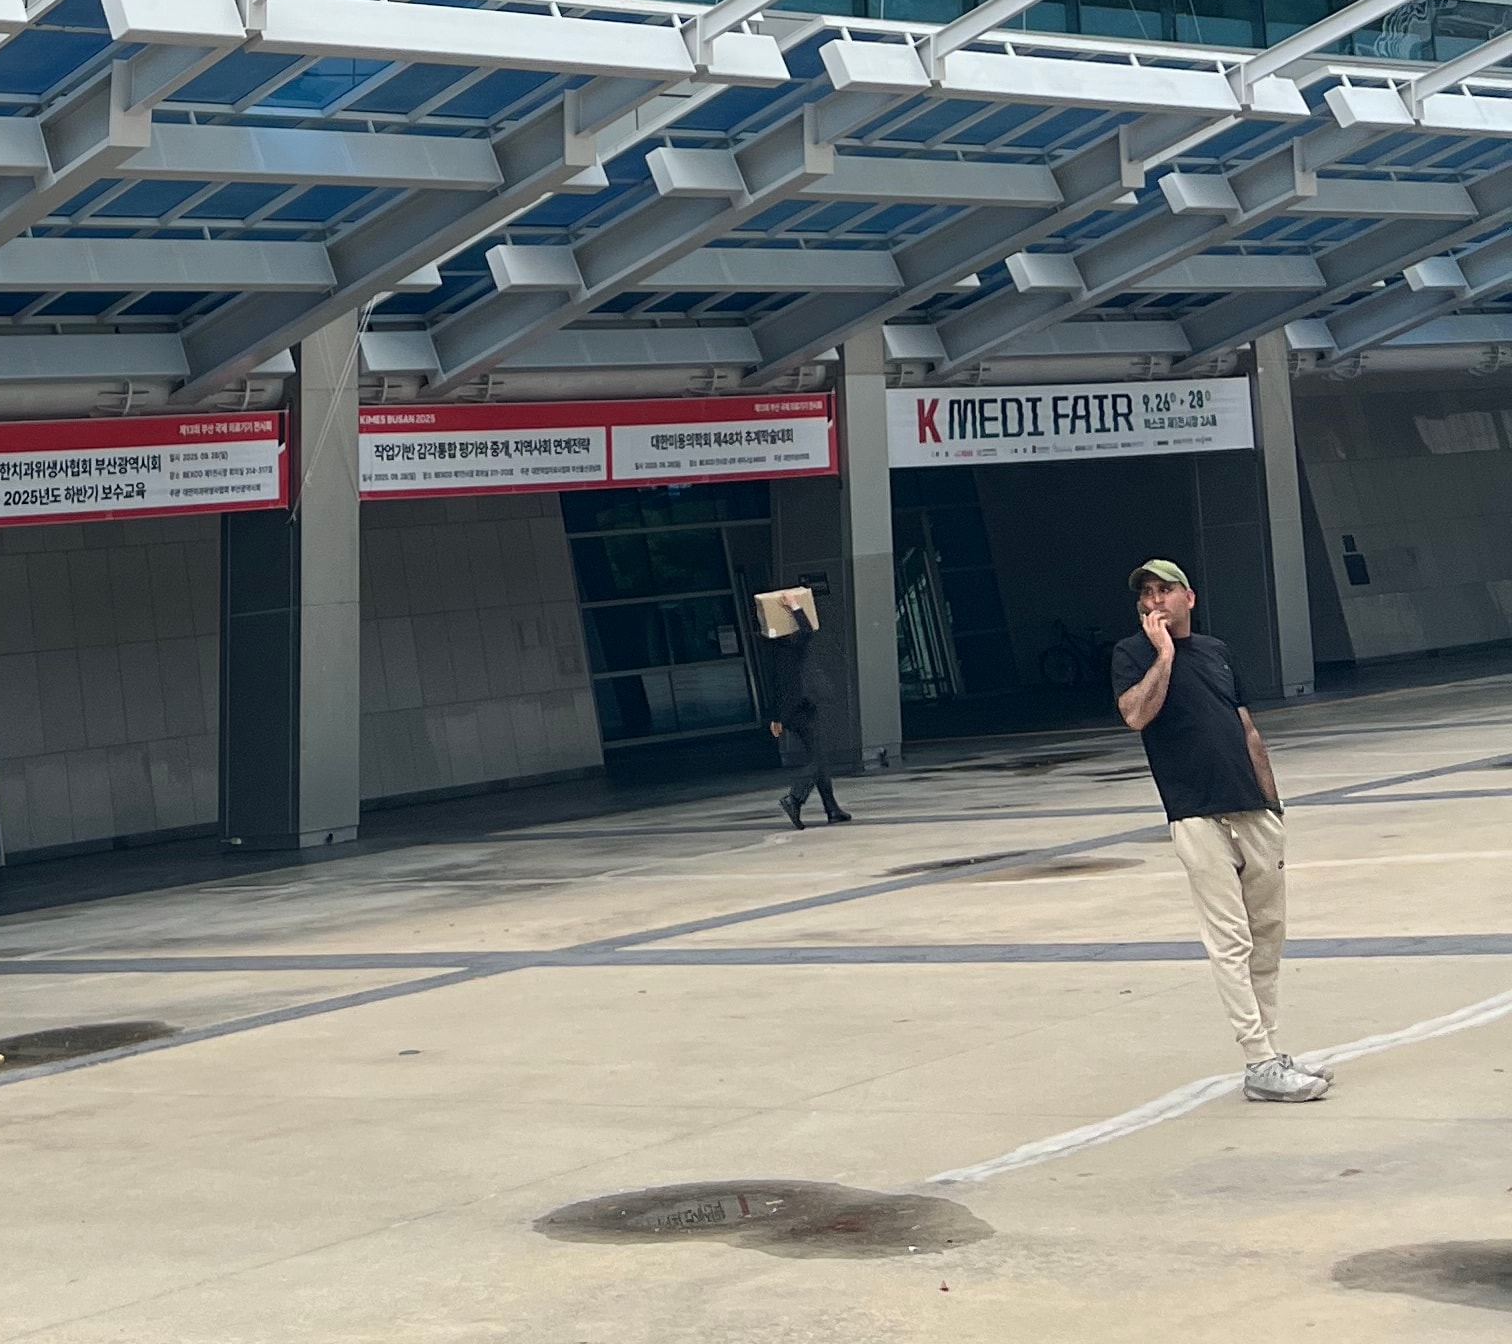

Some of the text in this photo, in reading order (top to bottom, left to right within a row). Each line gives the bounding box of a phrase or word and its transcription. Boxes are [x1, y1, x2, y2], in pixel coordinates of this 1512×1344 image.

[917, 393, 1134, 444] K MEDI FAIR
[374, 443, 415, 461] 작업기반
[417, 442, 457, 460] 감각통합
[458, 440, 488, 458] 평가와
[513, 438, 551, 456] 지역사회
[553, 437, 590, 455] 연계전략
[651, 429, 711, 450] 대한미용의학회
[95, 454, 161, 476] 부산광역시회
[3, 481, 146, 506] 2025년도 하반기 보수교육
